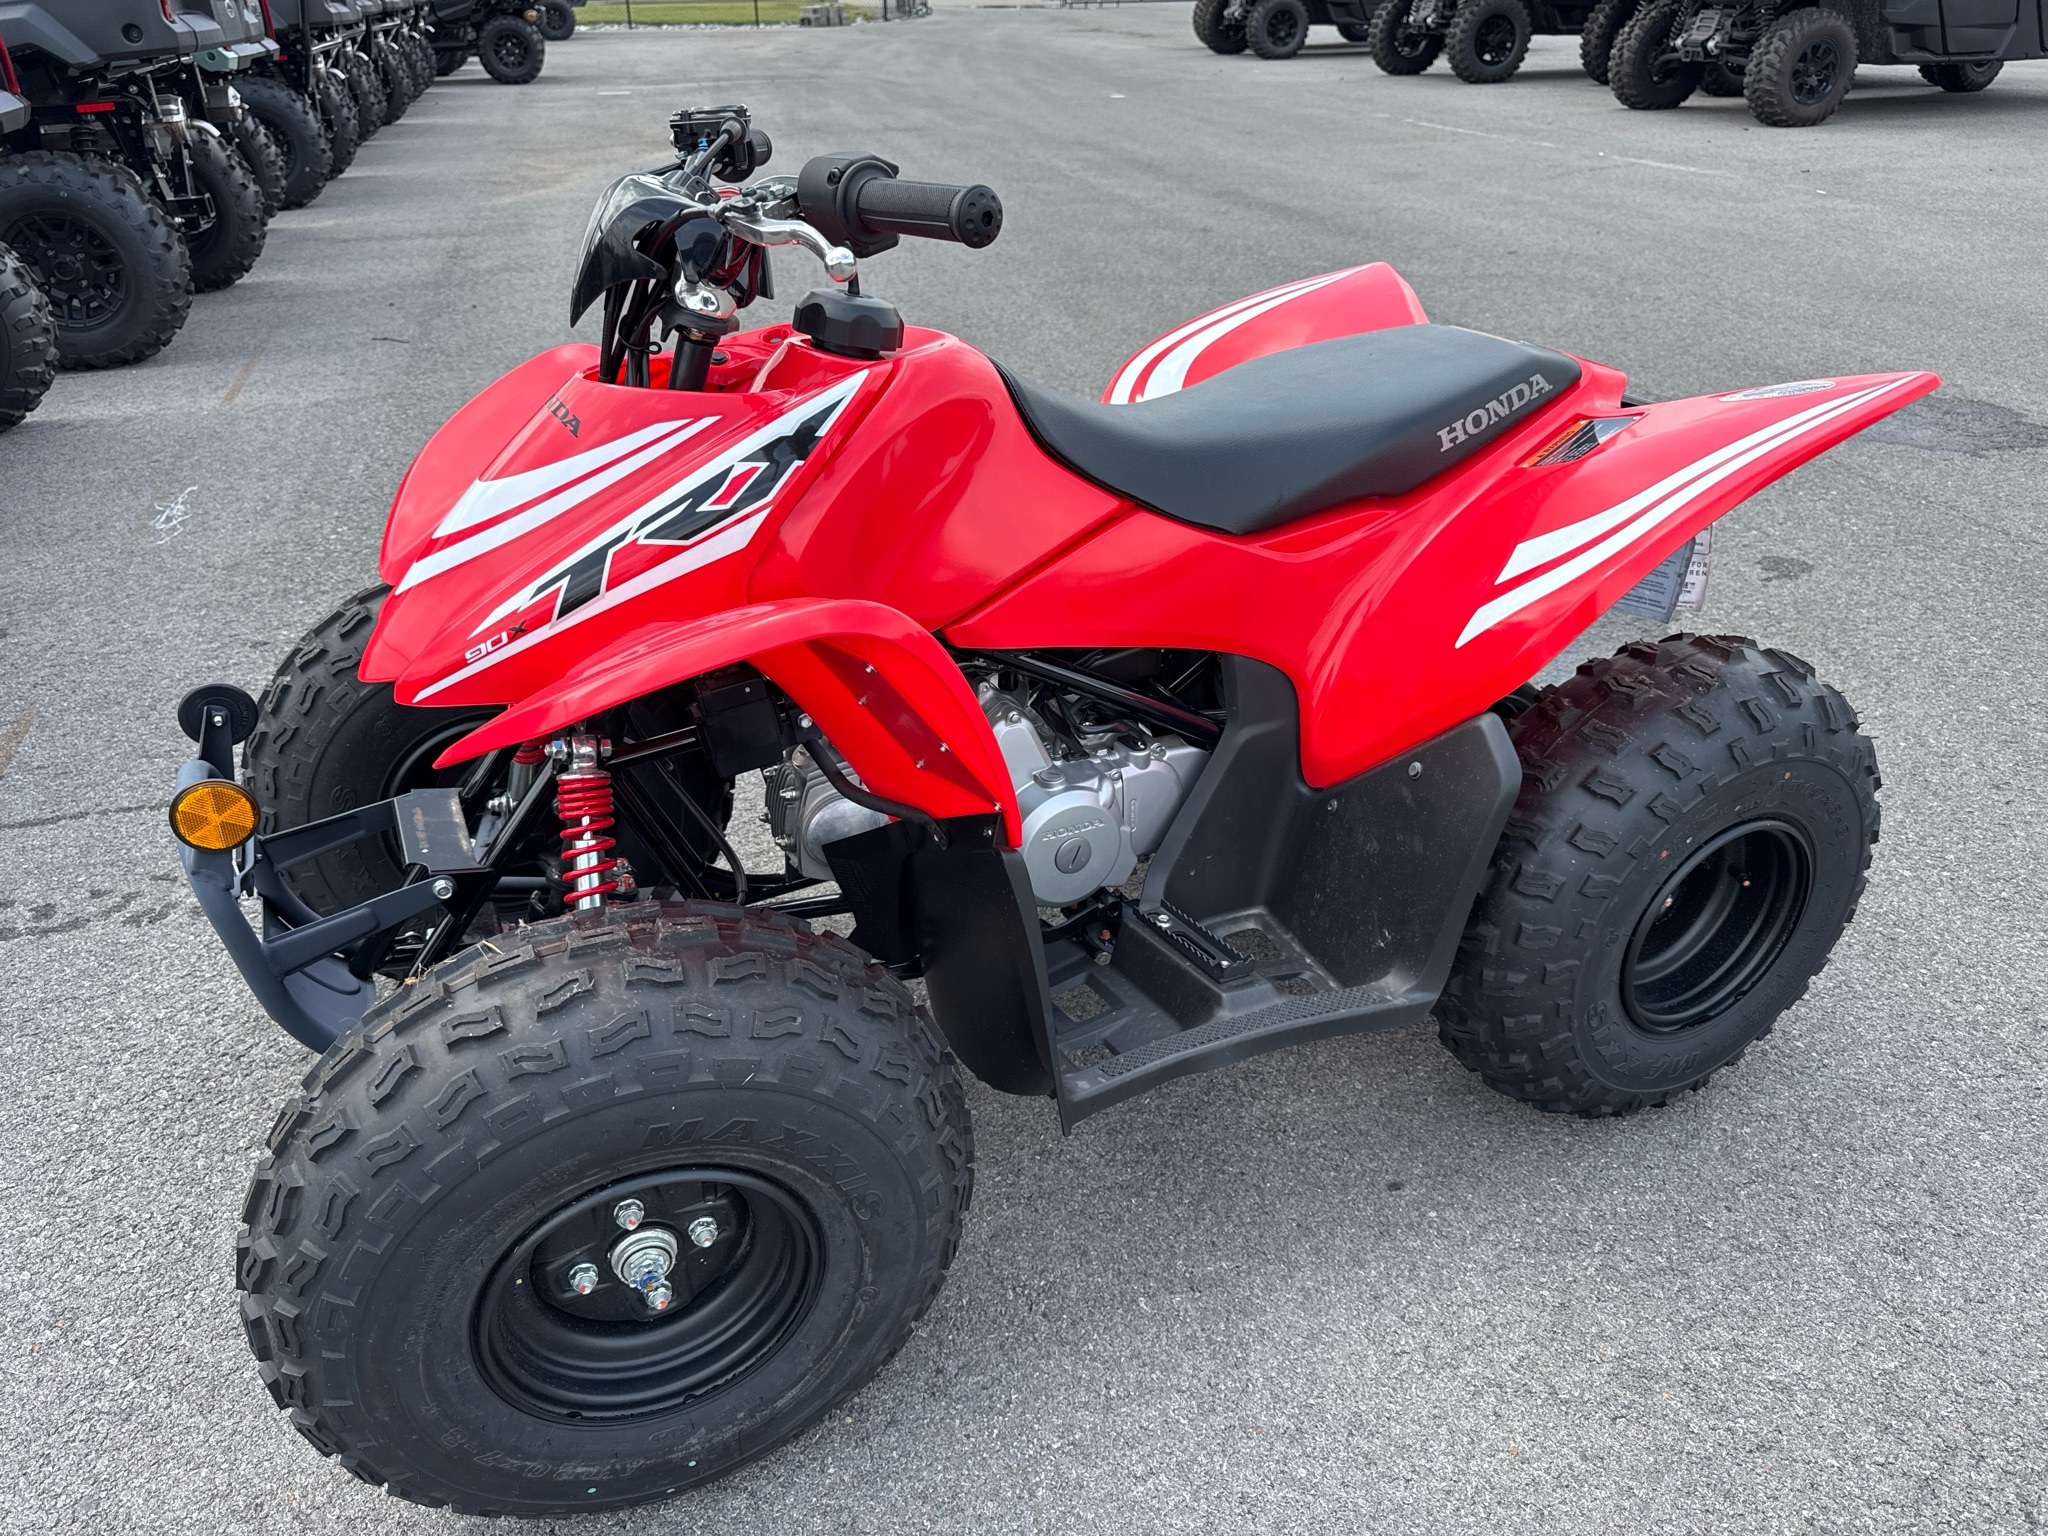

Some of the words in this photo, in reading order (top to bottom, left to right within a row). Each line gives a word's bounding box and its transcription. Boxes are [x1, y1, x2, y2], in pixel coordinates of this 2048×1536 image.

[546, 394, 581, 438] NDA
[1436, 373, 1554, 453] HONDA
[526, 394, 848, 622] TRX
[1042, 818, 1105, 841] HONDA
[641, 1117, 887, 1221] MAXXIS
